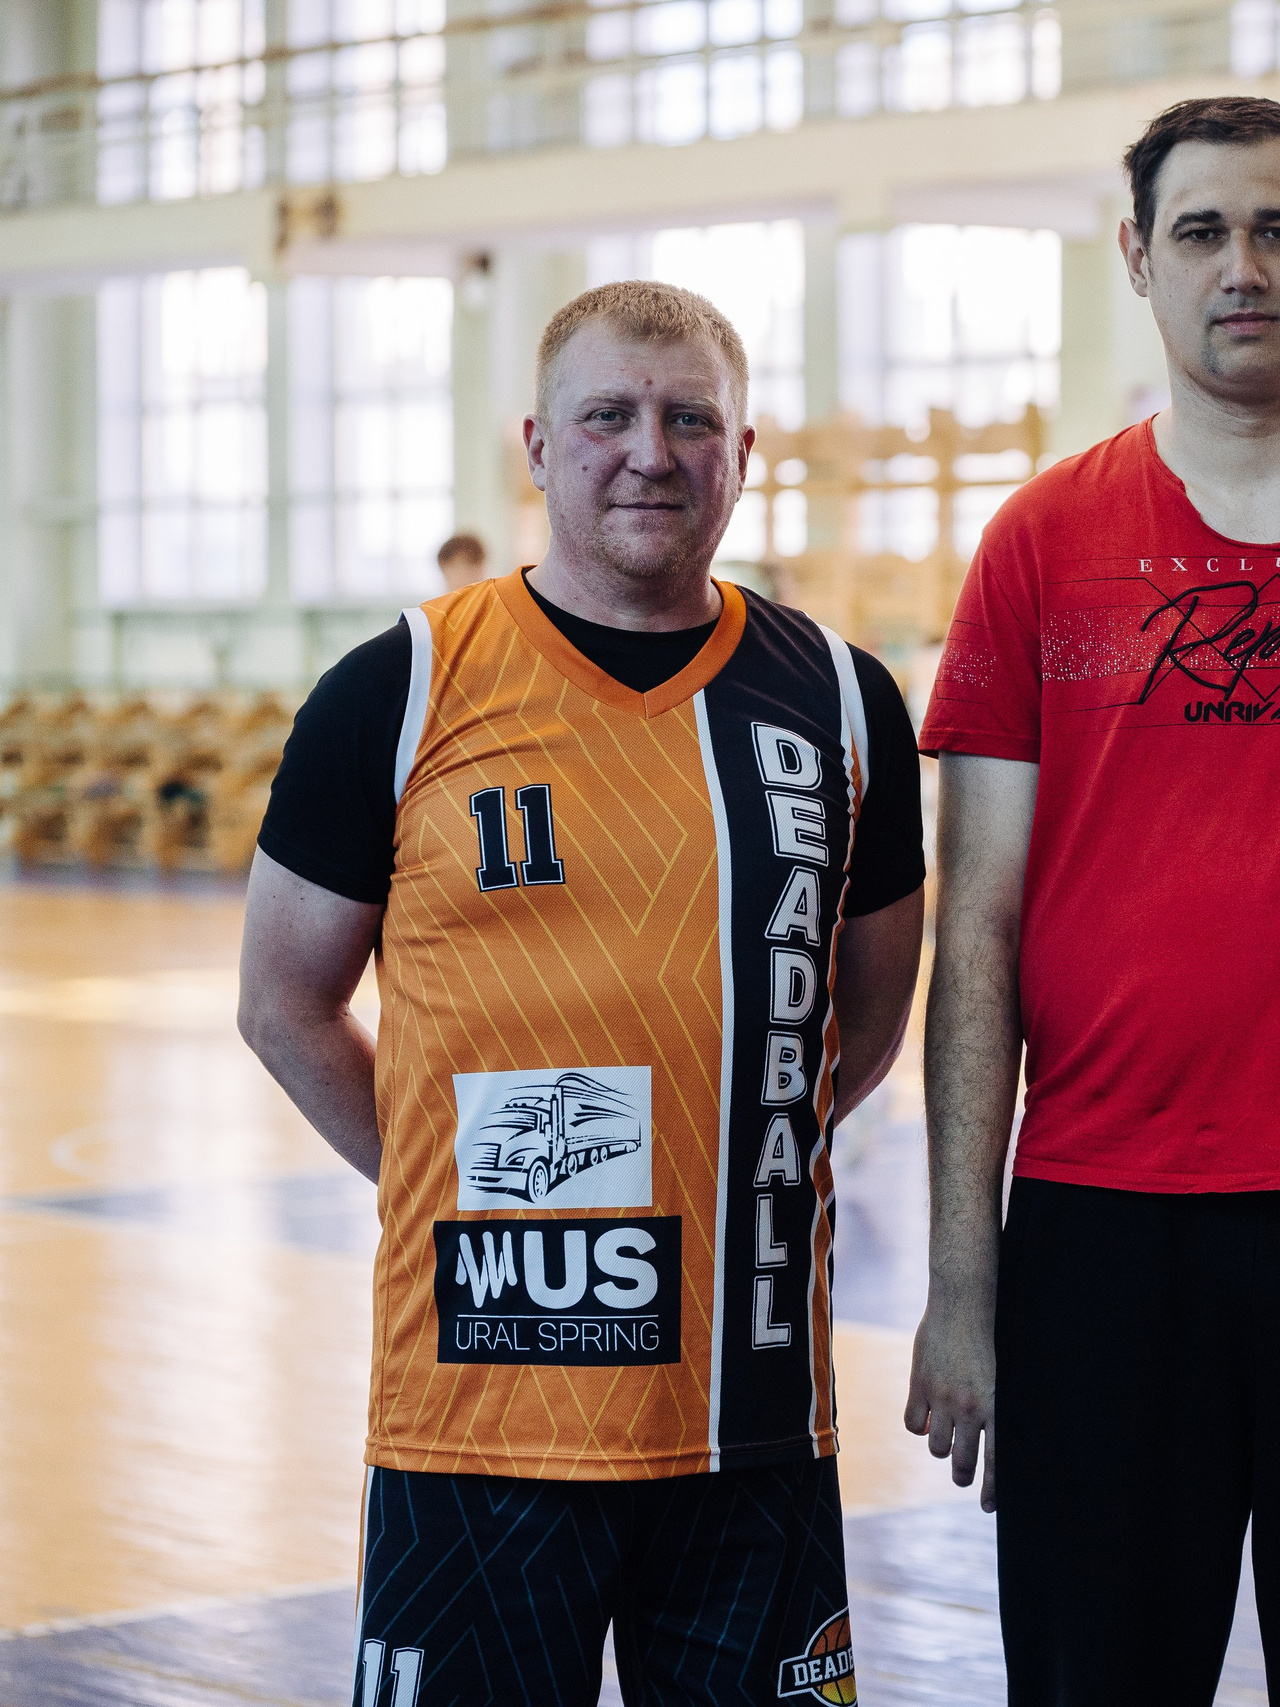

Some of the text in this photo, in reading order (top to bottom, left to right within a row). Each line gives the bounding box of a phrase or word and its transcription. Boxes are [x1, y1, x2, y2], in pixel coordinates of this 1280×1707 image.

[469, 784, 566, 892] 11
[751, 721, 829, 1350] DEADBALL
[455, 1321, 660, 1352] URAL SPRING
